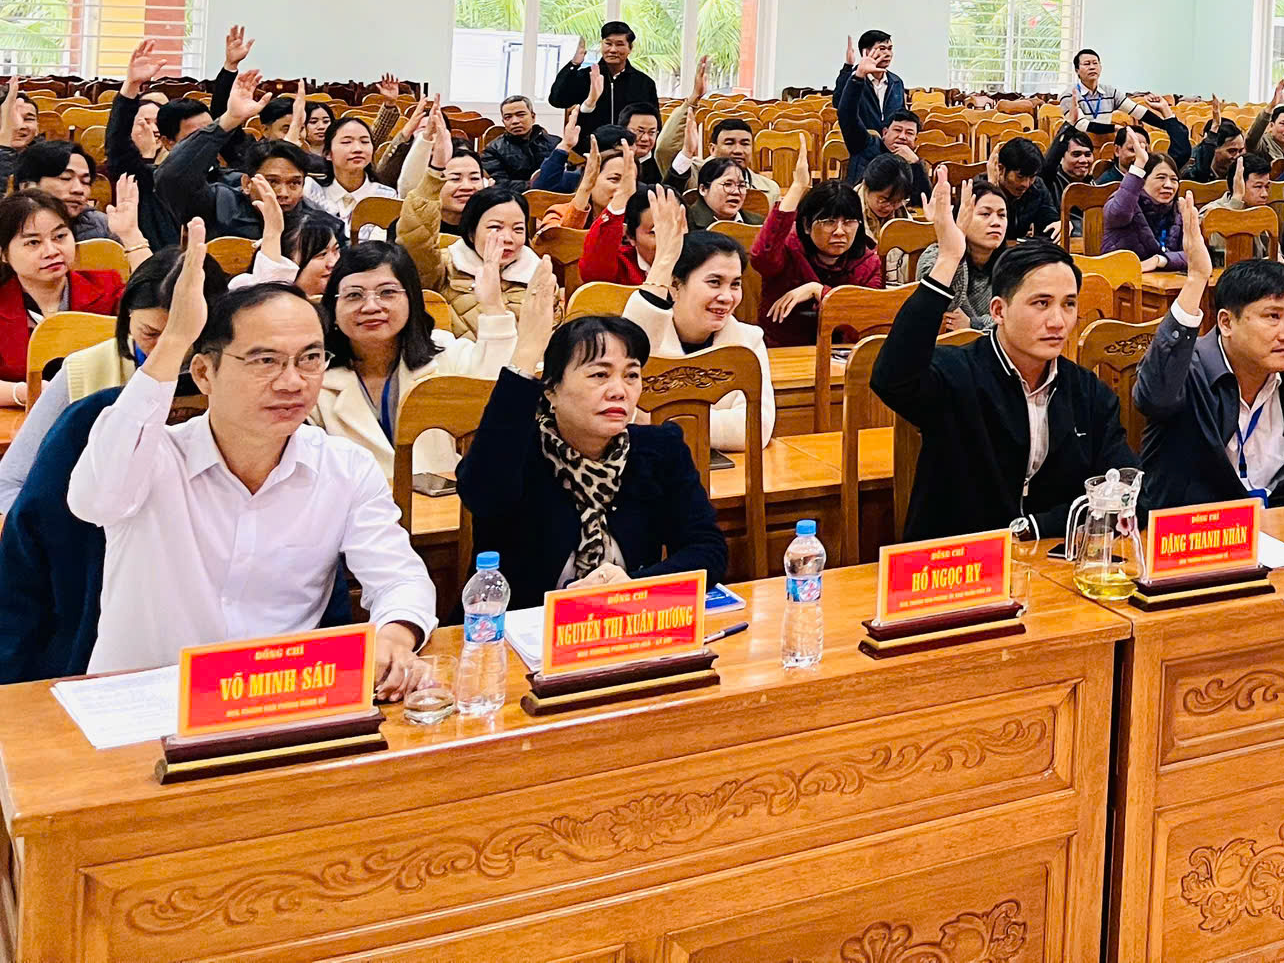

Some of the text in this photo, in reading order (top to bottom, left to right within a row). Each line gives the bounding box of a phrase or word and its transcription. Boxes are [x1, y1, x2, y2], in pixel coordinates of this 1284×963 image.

[1189, 529, 1220, 550] THANH
[931, 567, 963, 590] NGỌC
[556, 605, 693, 647] NGUYỄN THỊ XUÂN HƯƠNG
[220, 661, 336, 701] VÕ MINH SÁU
